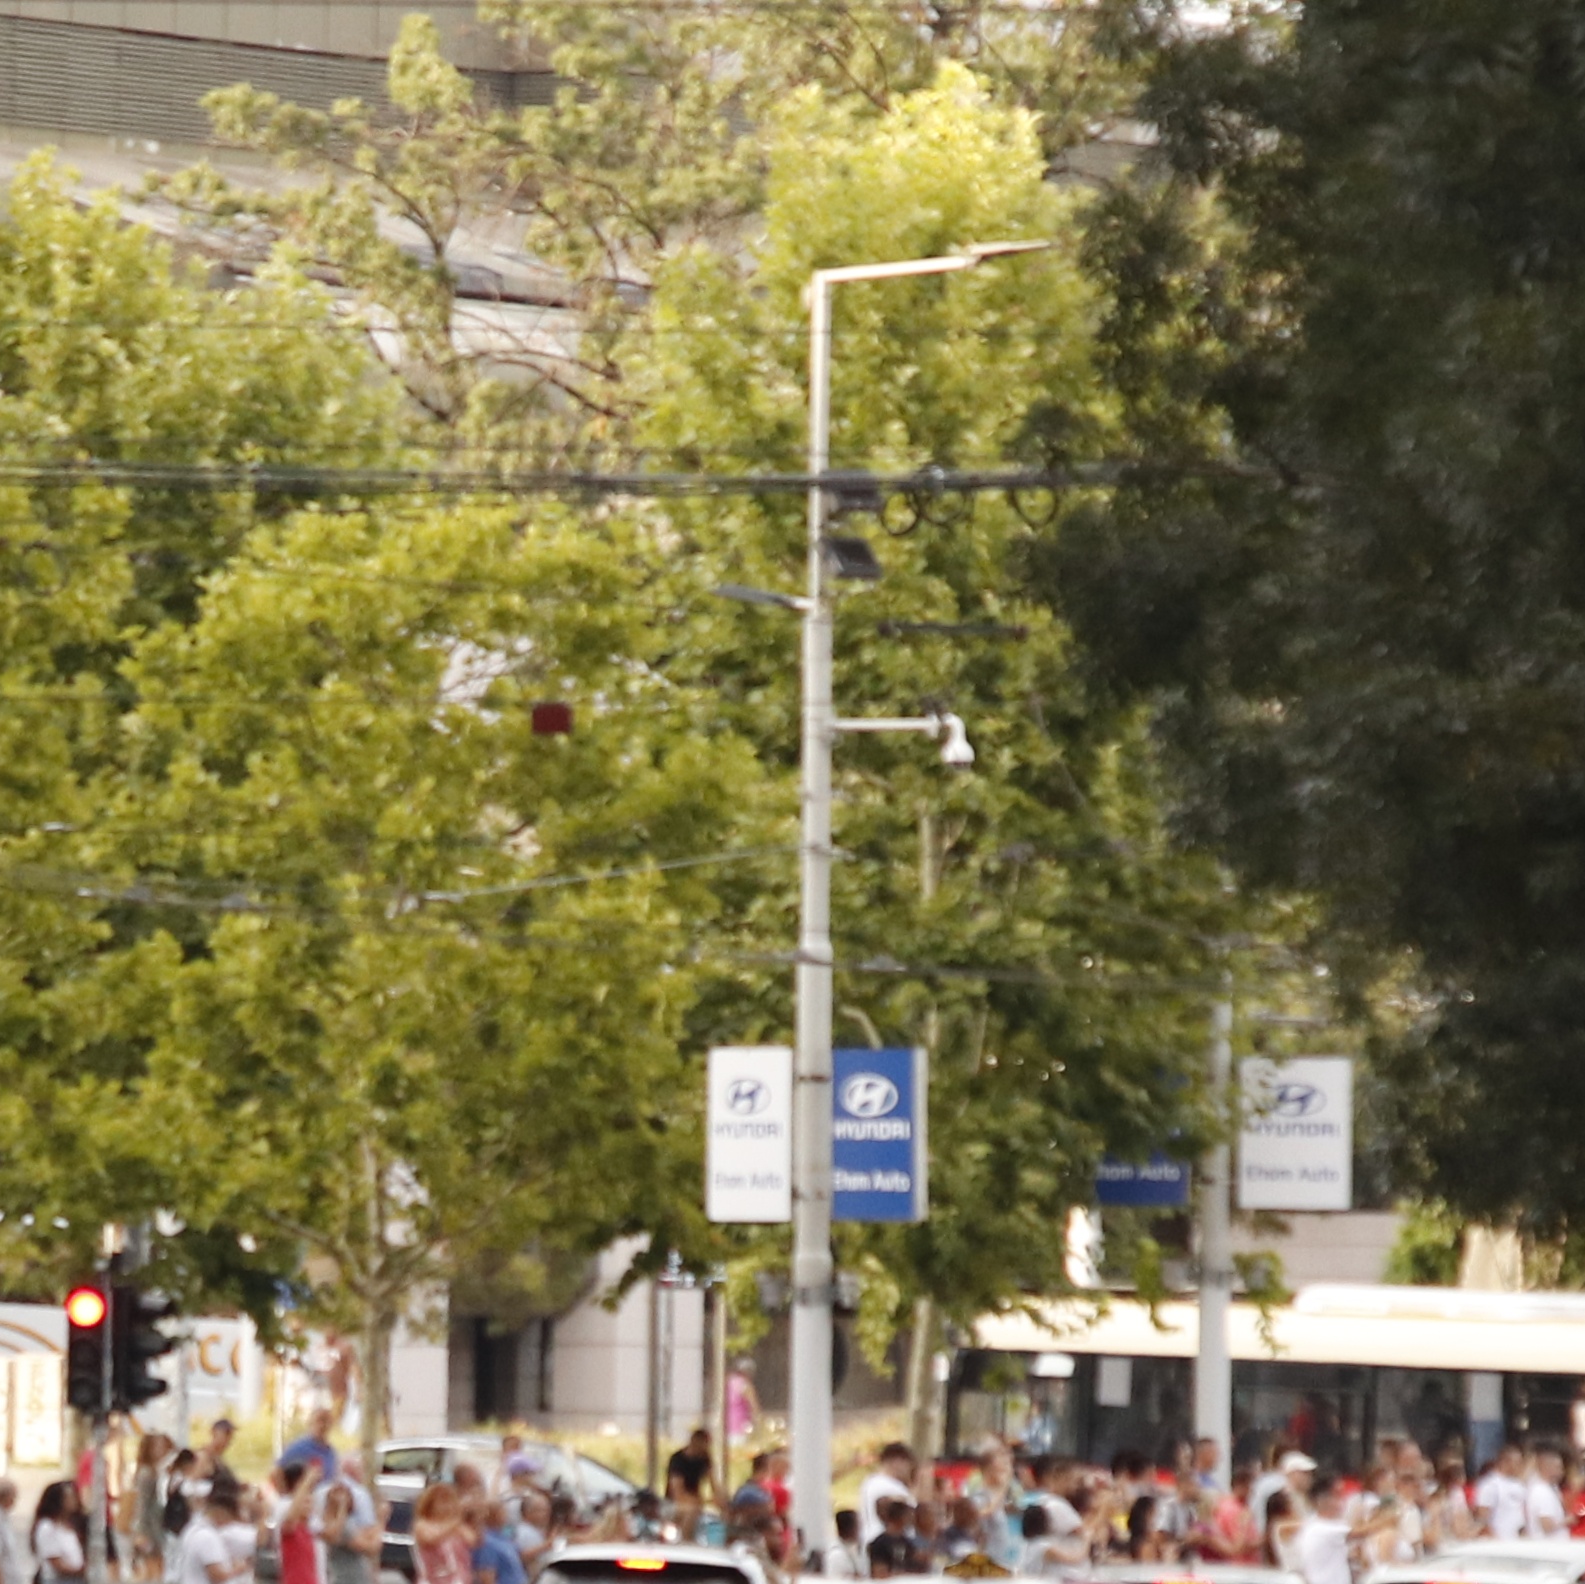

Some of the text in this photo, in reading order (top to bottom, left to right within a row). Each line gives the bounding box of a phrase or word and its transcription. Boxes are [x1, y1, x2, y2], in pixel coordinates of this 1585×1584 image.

[714, 1121, 784, 1138] HYUNDAI
[834, 1118, 911, 1141] HYUNDAI
[875, 1169, 910, 1192] Auto
[1299, 1165, 1341, 1183] Auto
